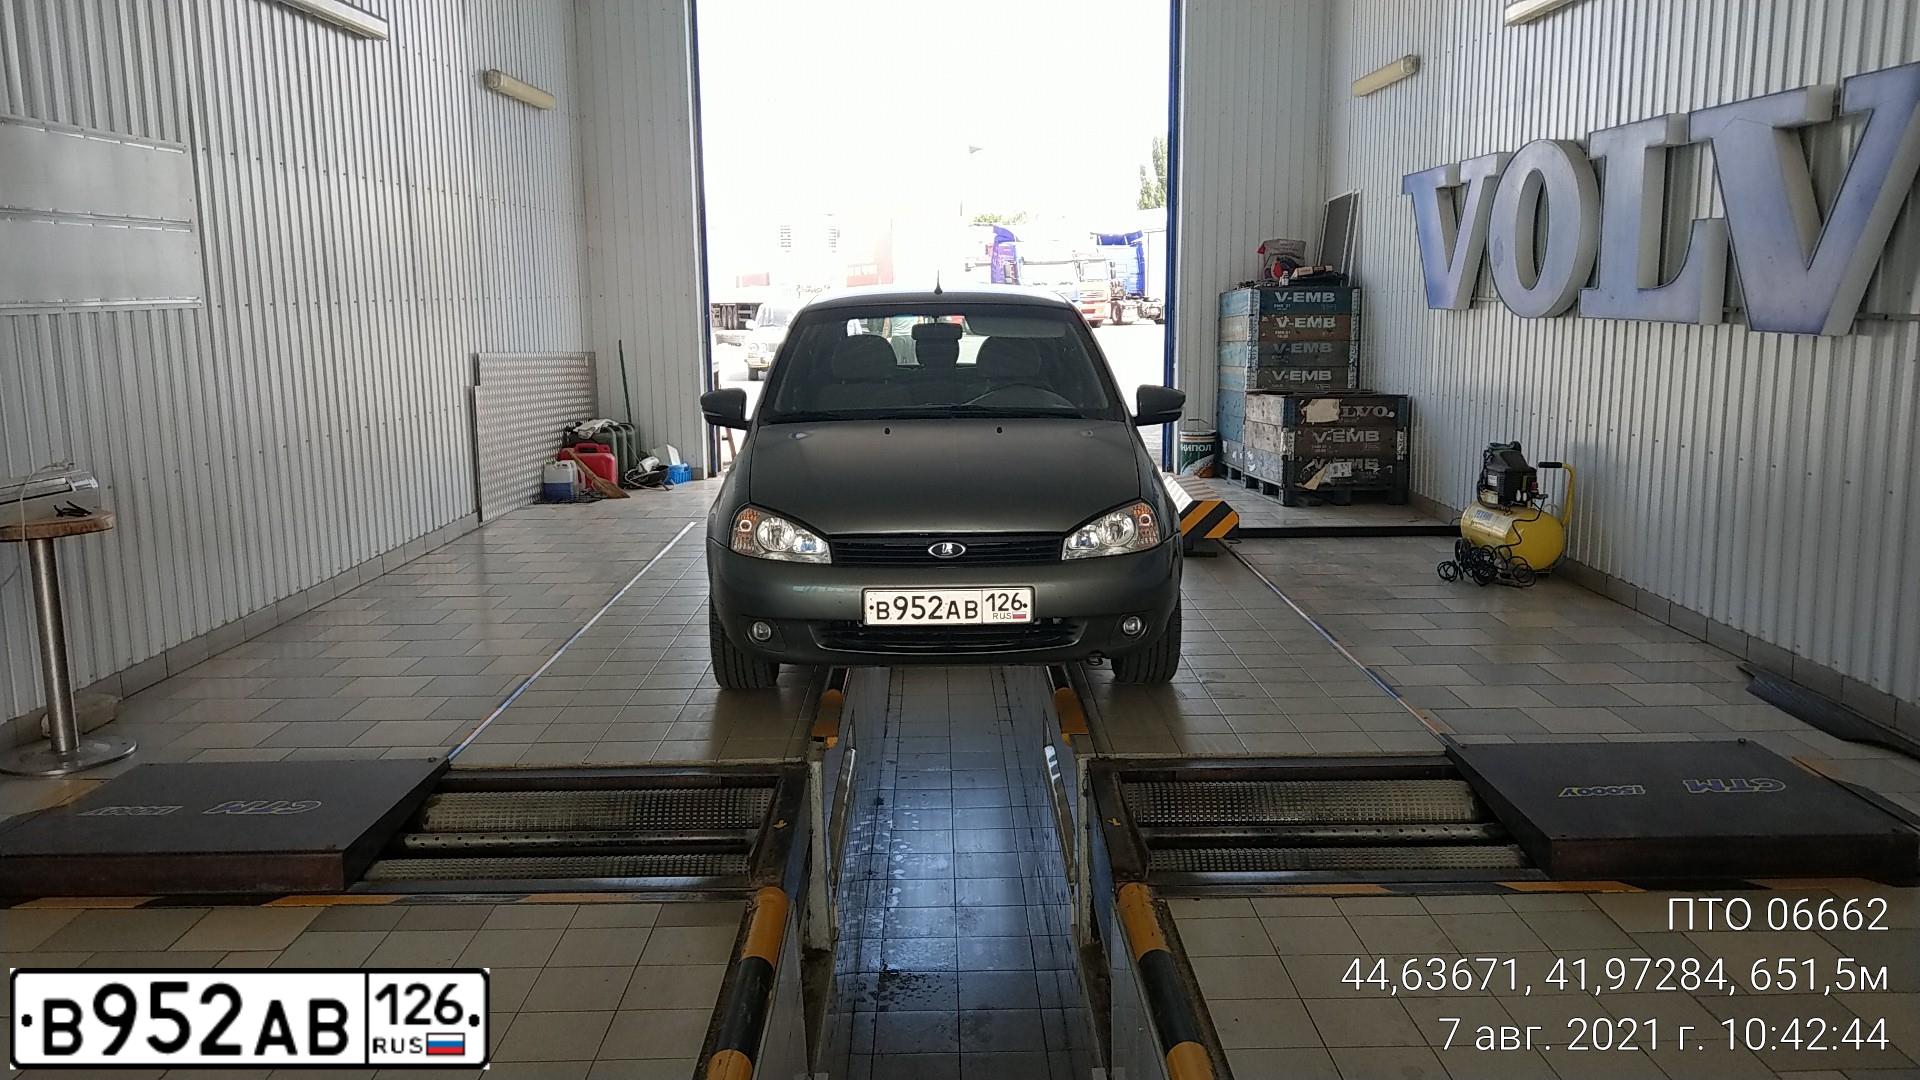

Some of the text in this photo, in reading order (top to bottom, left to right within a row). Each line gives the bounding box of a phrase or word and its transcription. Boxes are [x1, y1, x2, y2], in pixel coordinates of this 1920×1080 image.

[1402, 61, 1920, 336] VOLV
[1274, 291, 1336, 303] V-EMB
[1275, 315, 1336, 329] V-EMB
[1272, 342, 1333, 354] V-EMB
[1271, 370, 1332, 382] V-EMB
[1312, 430, 1380, 443] V-EMB
[985, 593, 1023, 612] 126
[992, 612, 1012, 620] RUS
